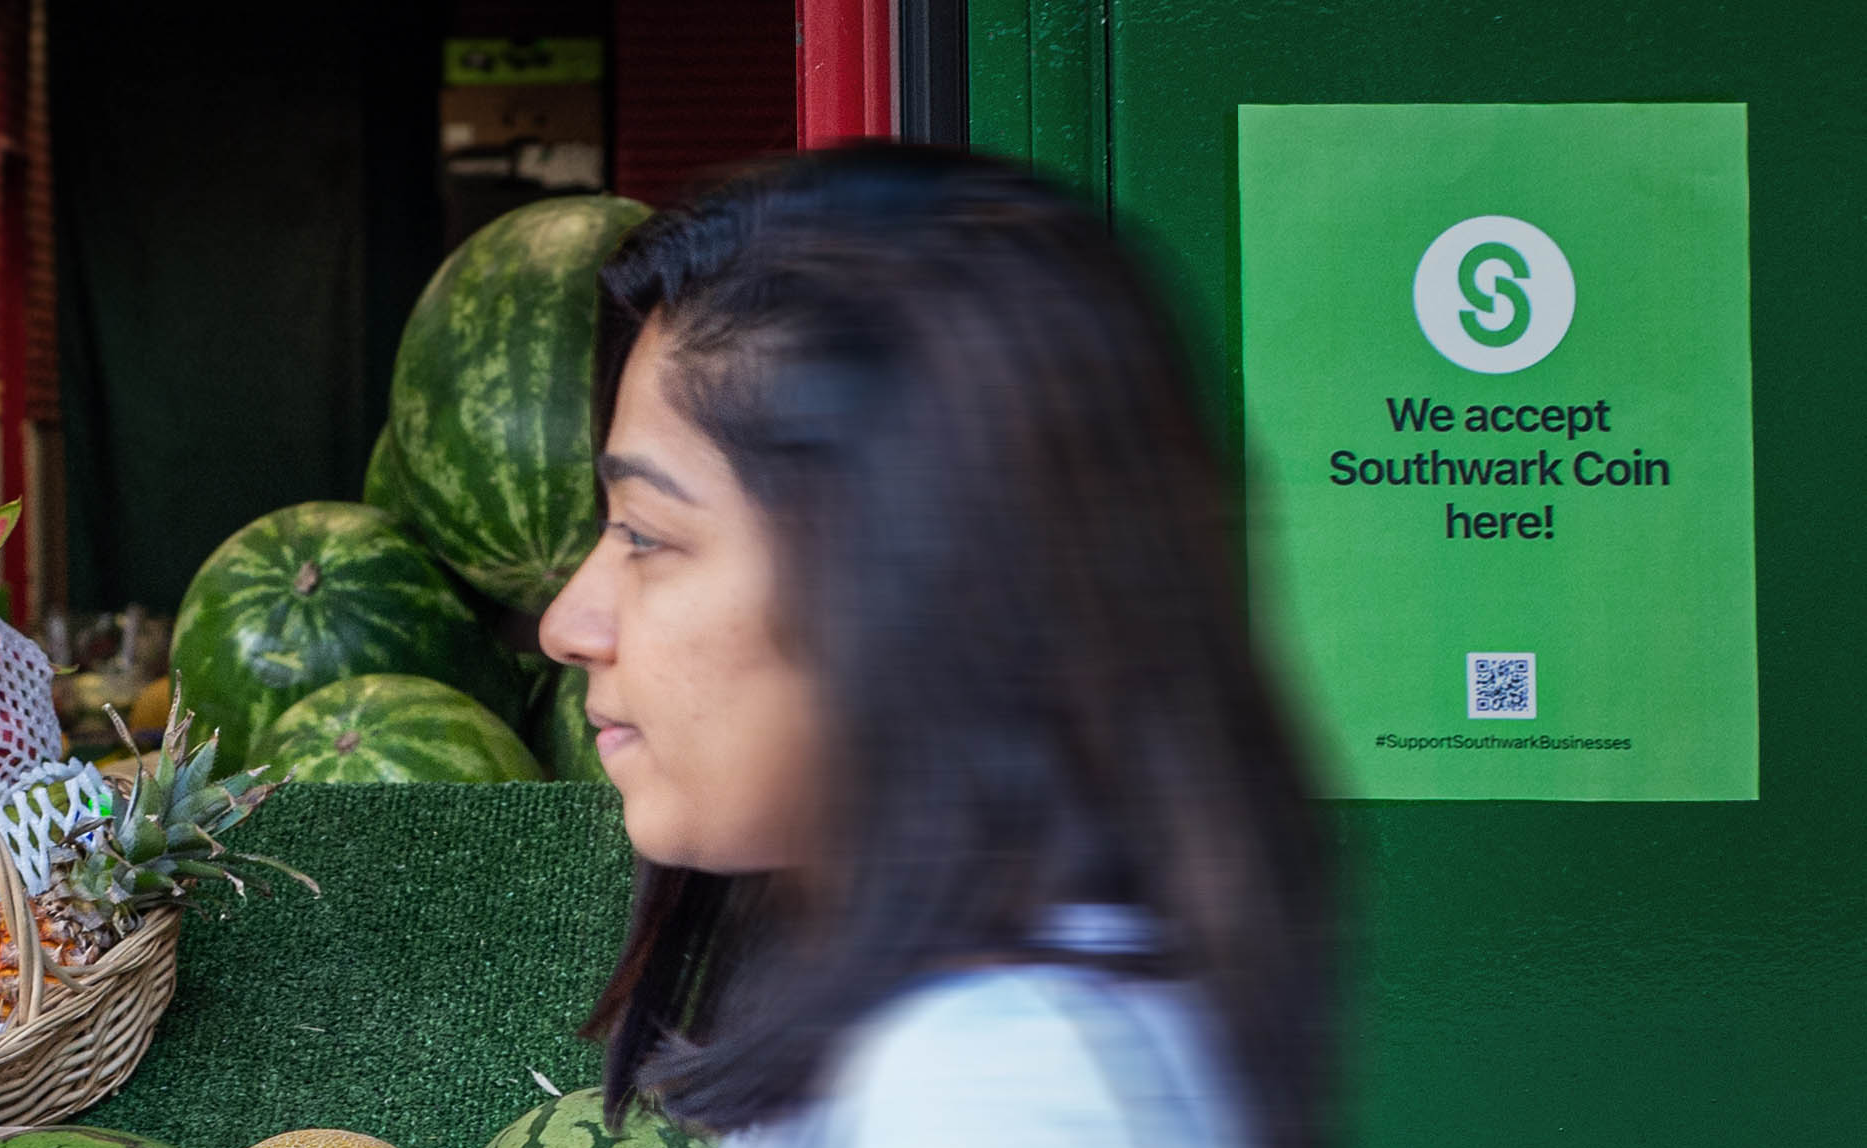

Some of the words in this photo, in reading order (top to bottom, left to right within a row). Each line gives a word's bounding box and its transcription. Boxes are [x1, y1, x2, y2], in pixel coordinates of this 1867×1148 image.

[1385, 397, 1456, 433] We
[1464, 399, 1612, 441] accept
[1329, 448, 1564, 486] Southwark
[1573, 447, 1671, 487] Coin
[1446, 502, 1555, 540] here!
[1375, 732, 1632, 752] #SupportSouthwarkBusinesses
